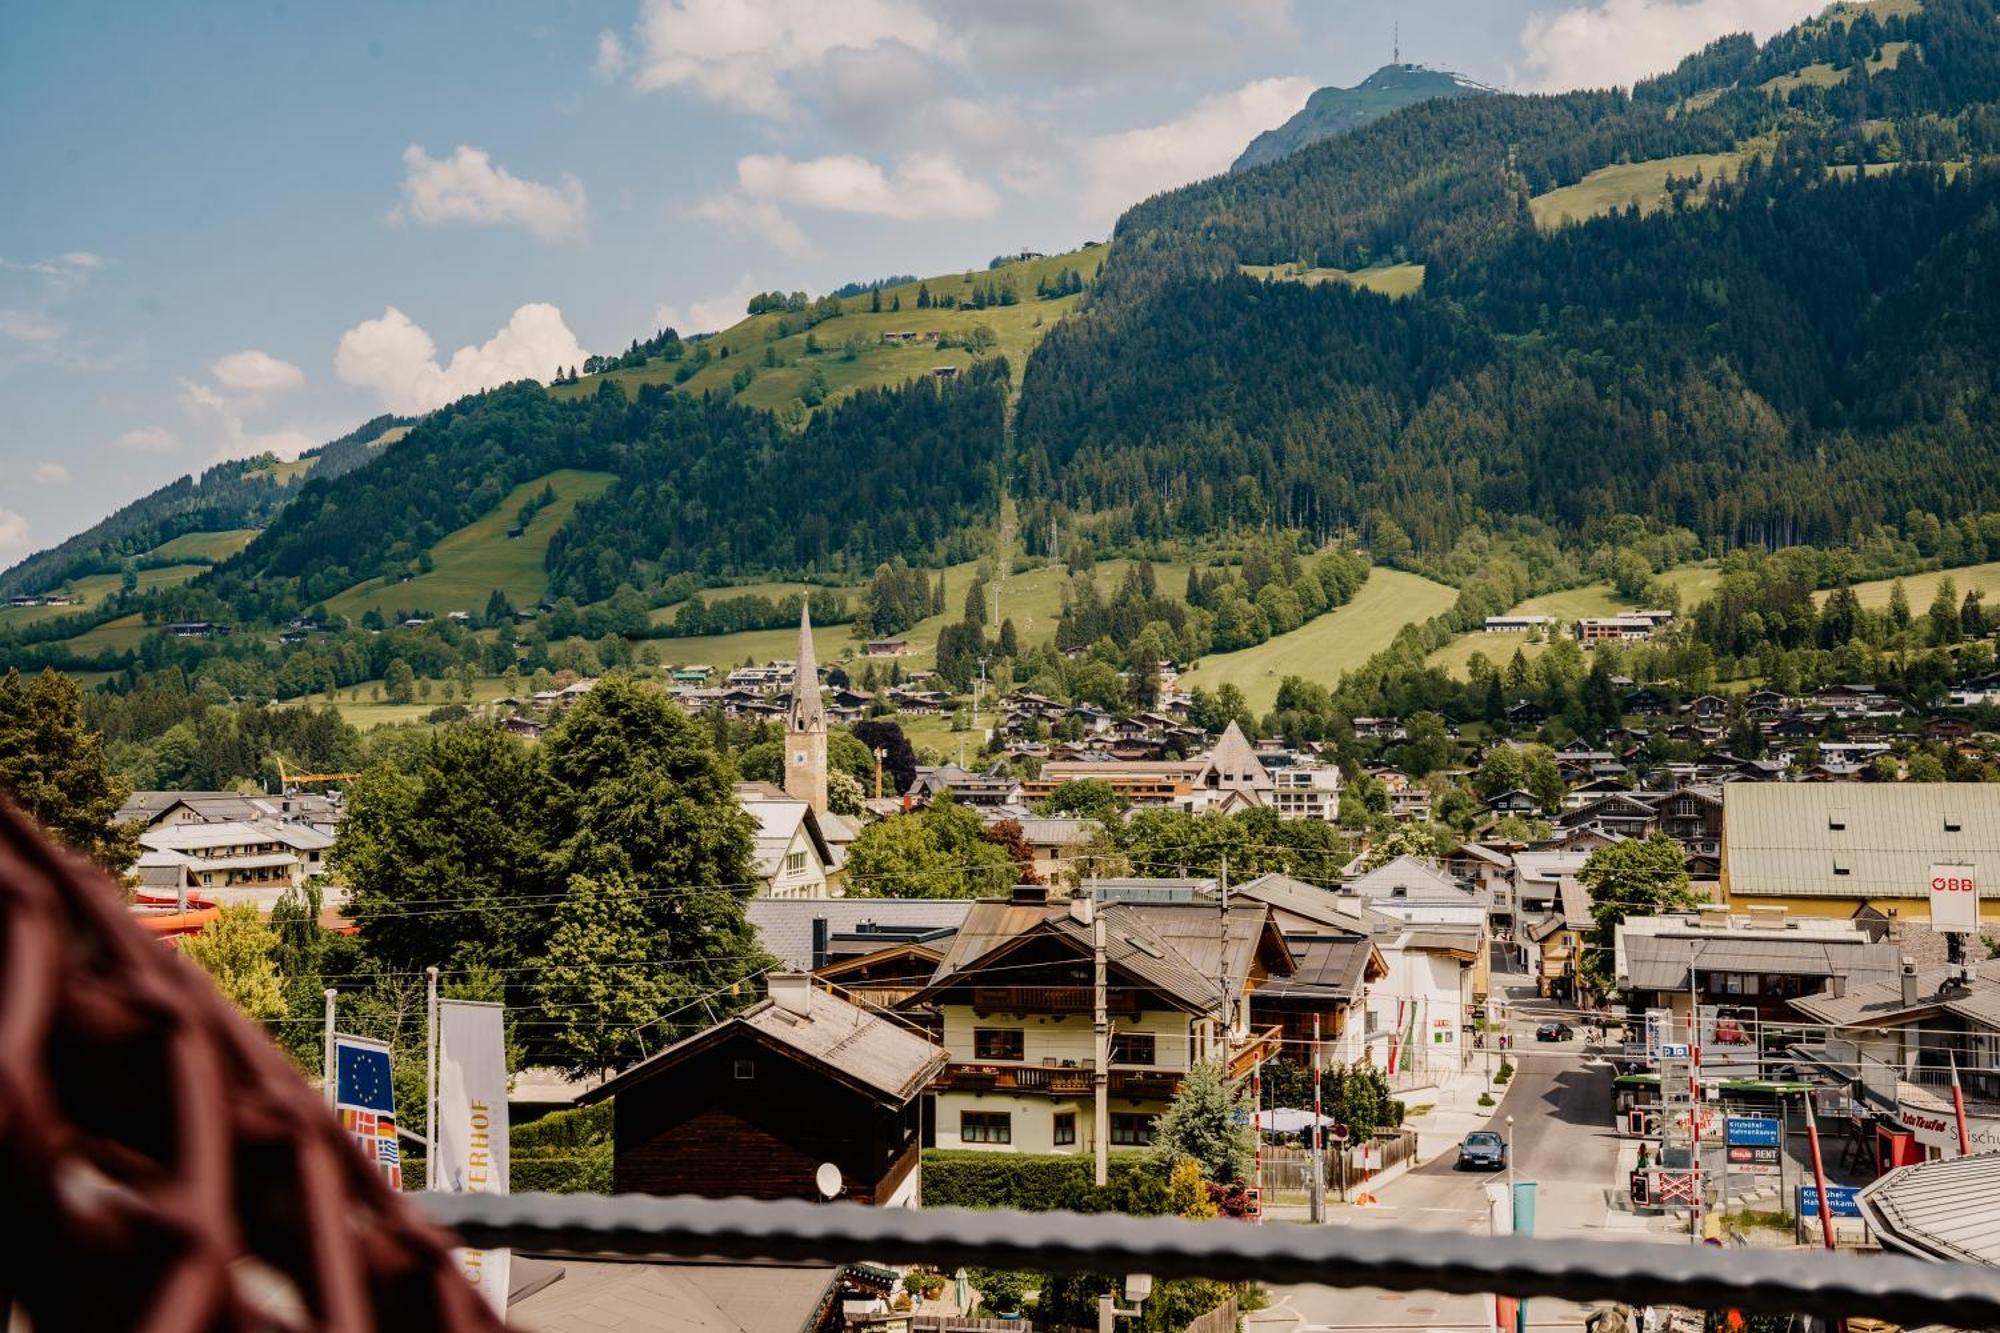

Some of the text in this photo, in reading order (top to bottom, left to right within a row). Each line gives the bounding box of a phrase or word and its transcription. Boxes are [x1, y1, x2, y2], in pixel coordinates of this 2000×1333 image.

[1932, 877, 1973, 891] ÖBB
[1950, 1125, 2000, 1145] Sisch
[1755, 1150, 1777, 1159] RENT
